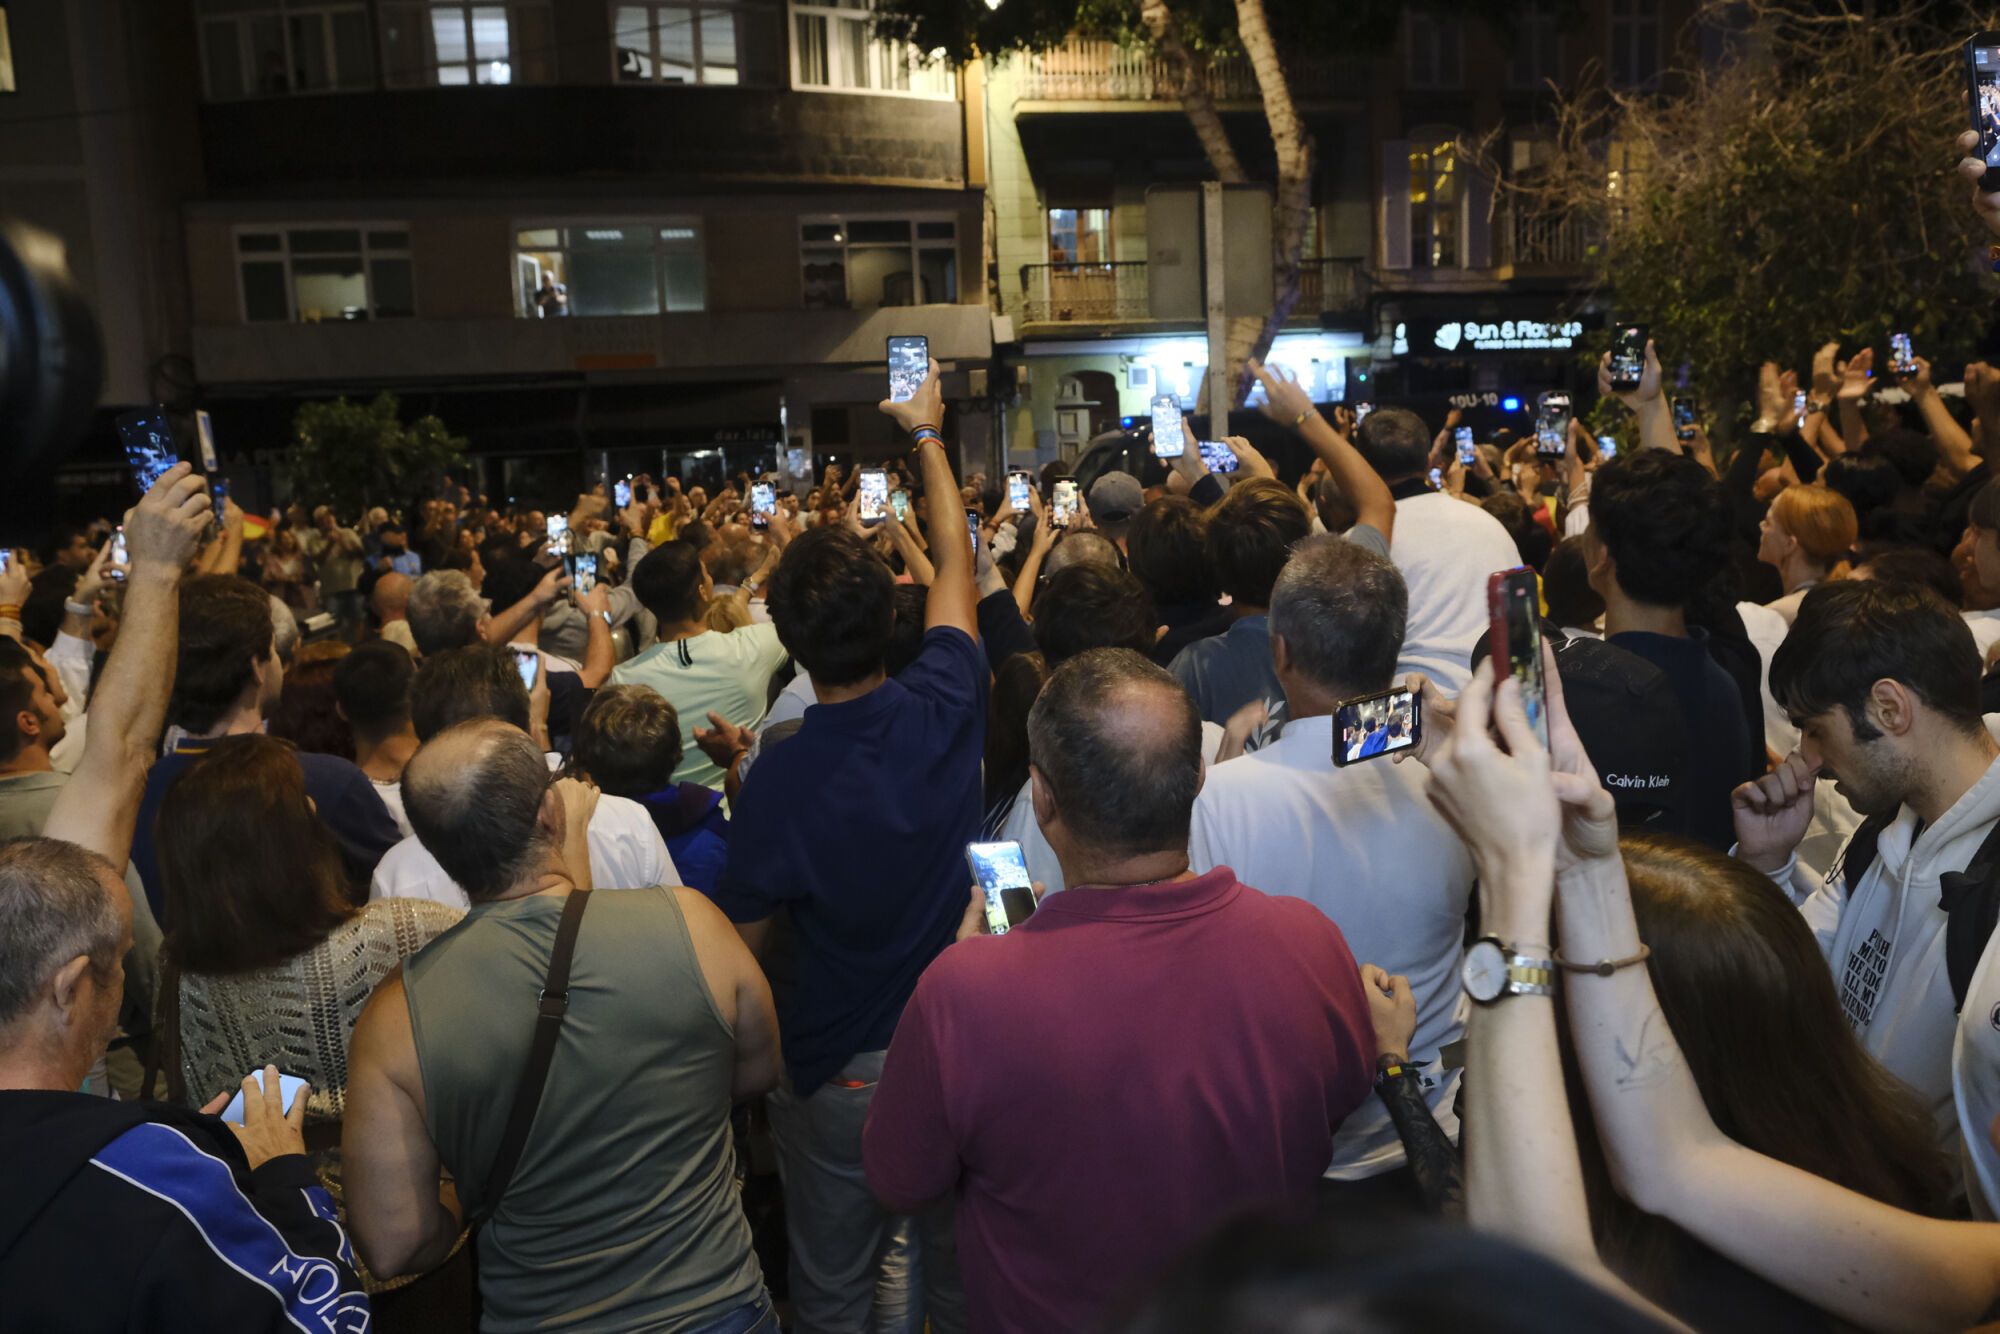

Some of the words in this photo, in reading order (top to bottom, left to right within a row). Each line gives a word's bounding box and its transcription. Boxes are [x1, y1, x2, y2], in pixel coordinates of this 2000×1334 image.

[1464, 321, 1499, 340] Sun
[1500, 320, 1516, 339] &
[1606, 773, 1646, 788] Calvin
[1873, 955, 1887, 974] TO
[1844, 970, 1860, 996] ALL
[1862, 987, 1877, 1008] MY
[1840, 986, 1872, 1026] RIENDS
